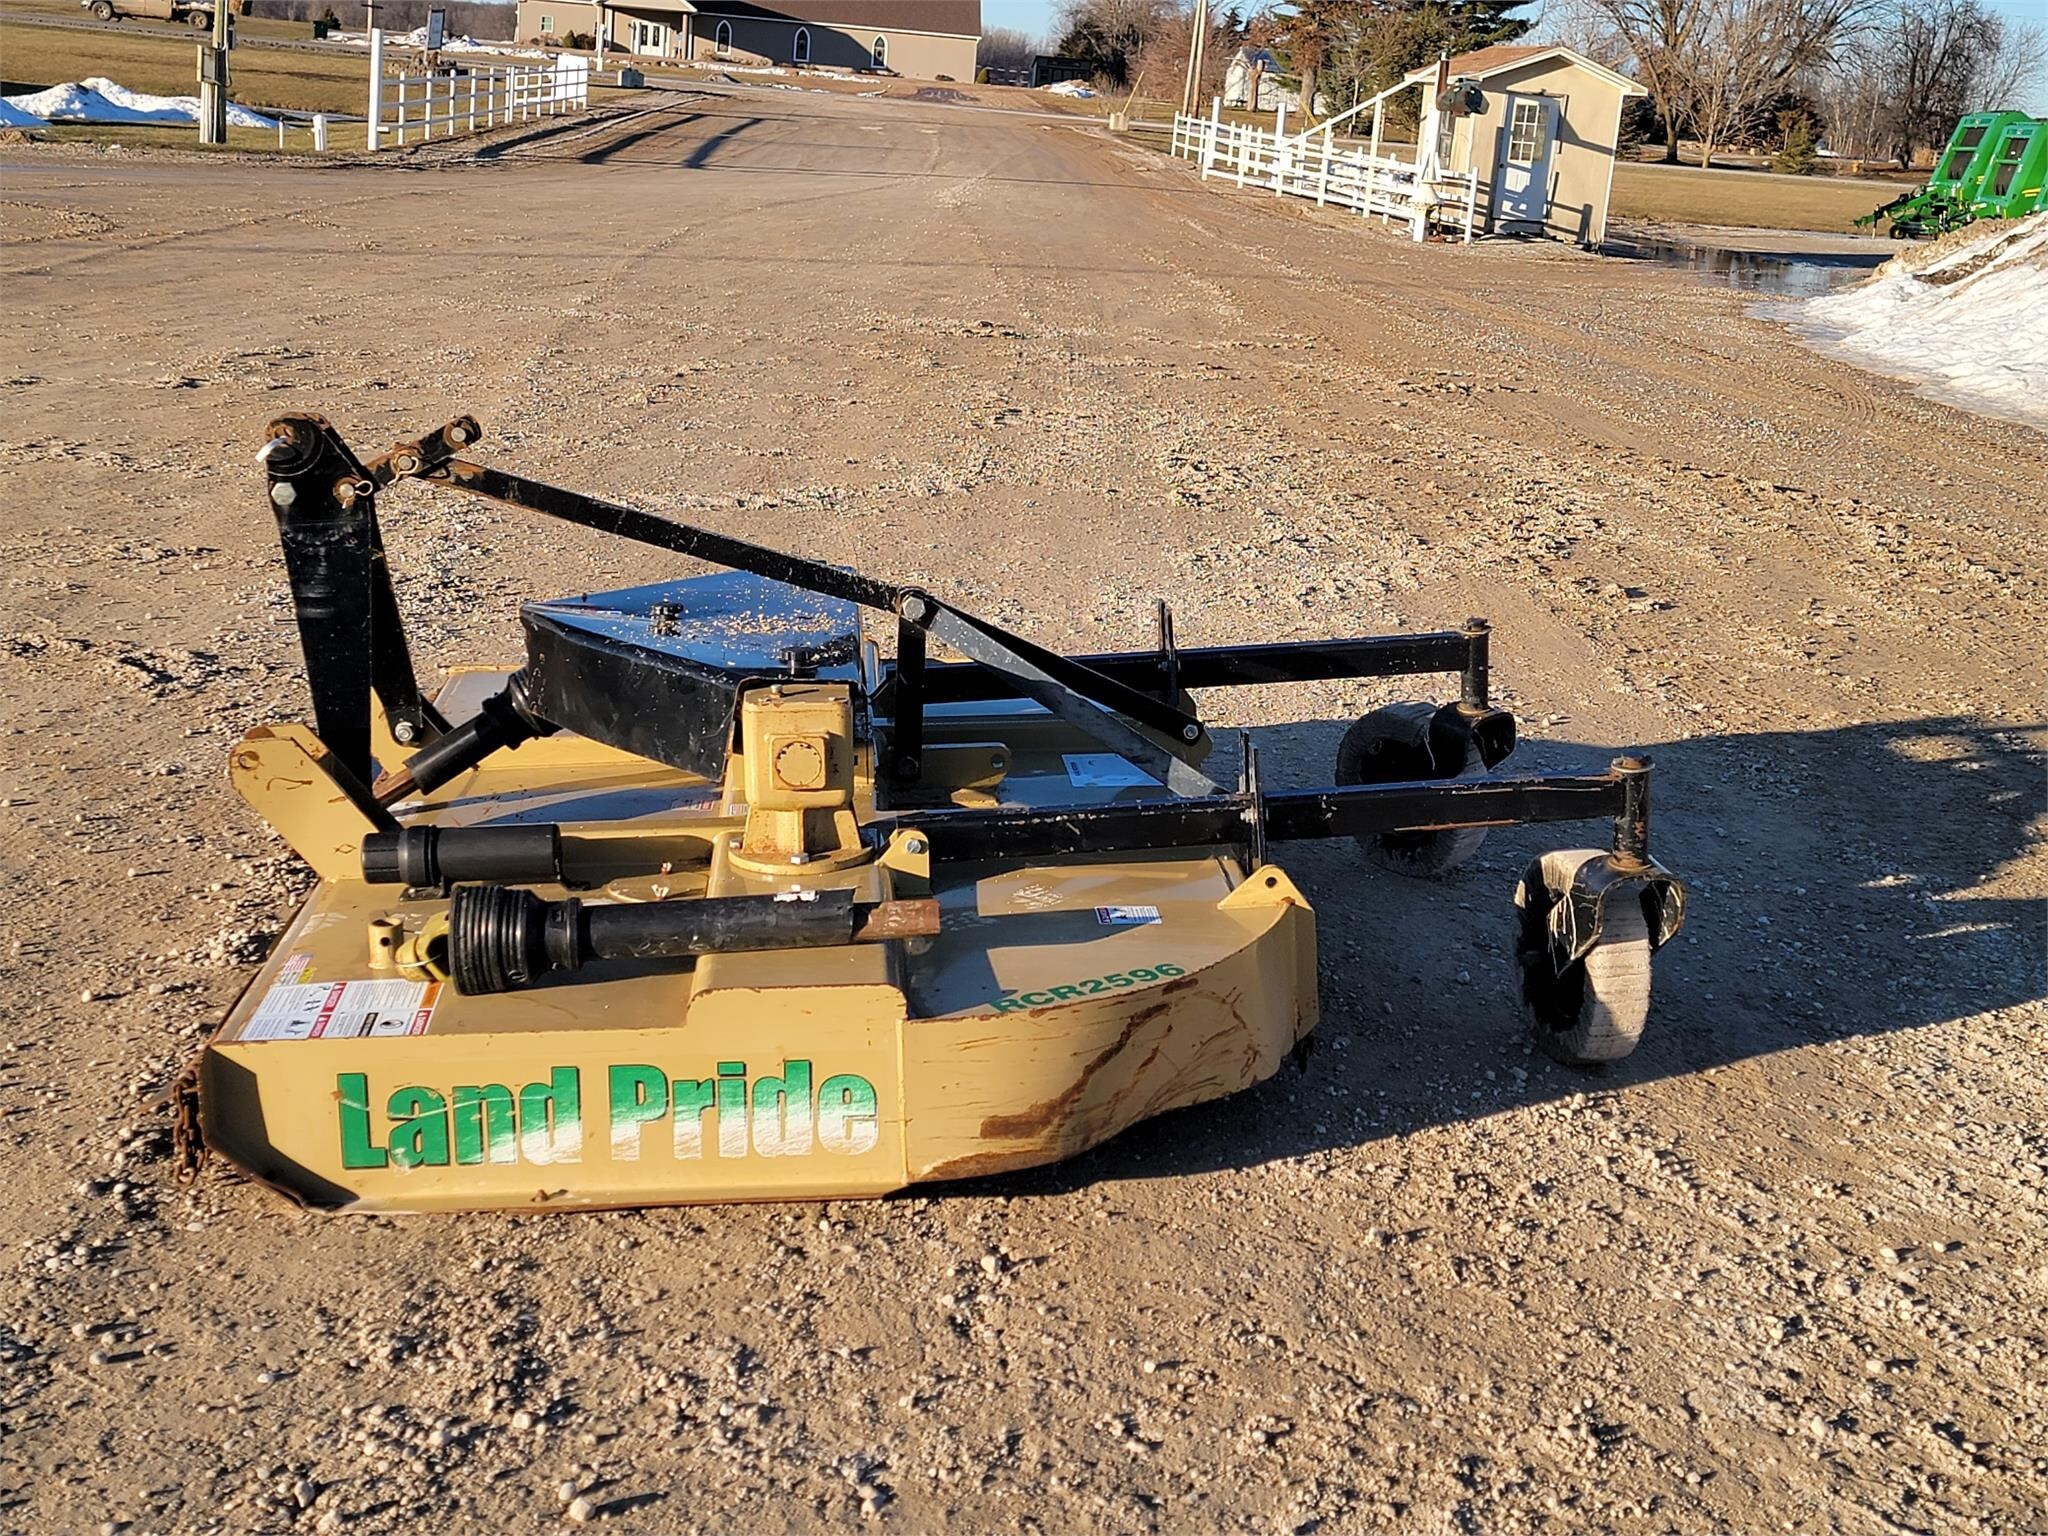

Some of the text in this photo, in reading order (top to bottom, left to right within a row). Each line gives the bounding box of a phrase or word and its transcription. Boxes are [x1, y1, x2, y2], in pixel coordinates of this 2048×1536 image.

[990, 963, 1185, 1012] RCR2596
[337, 1059, 880, 1170] Land Pride
